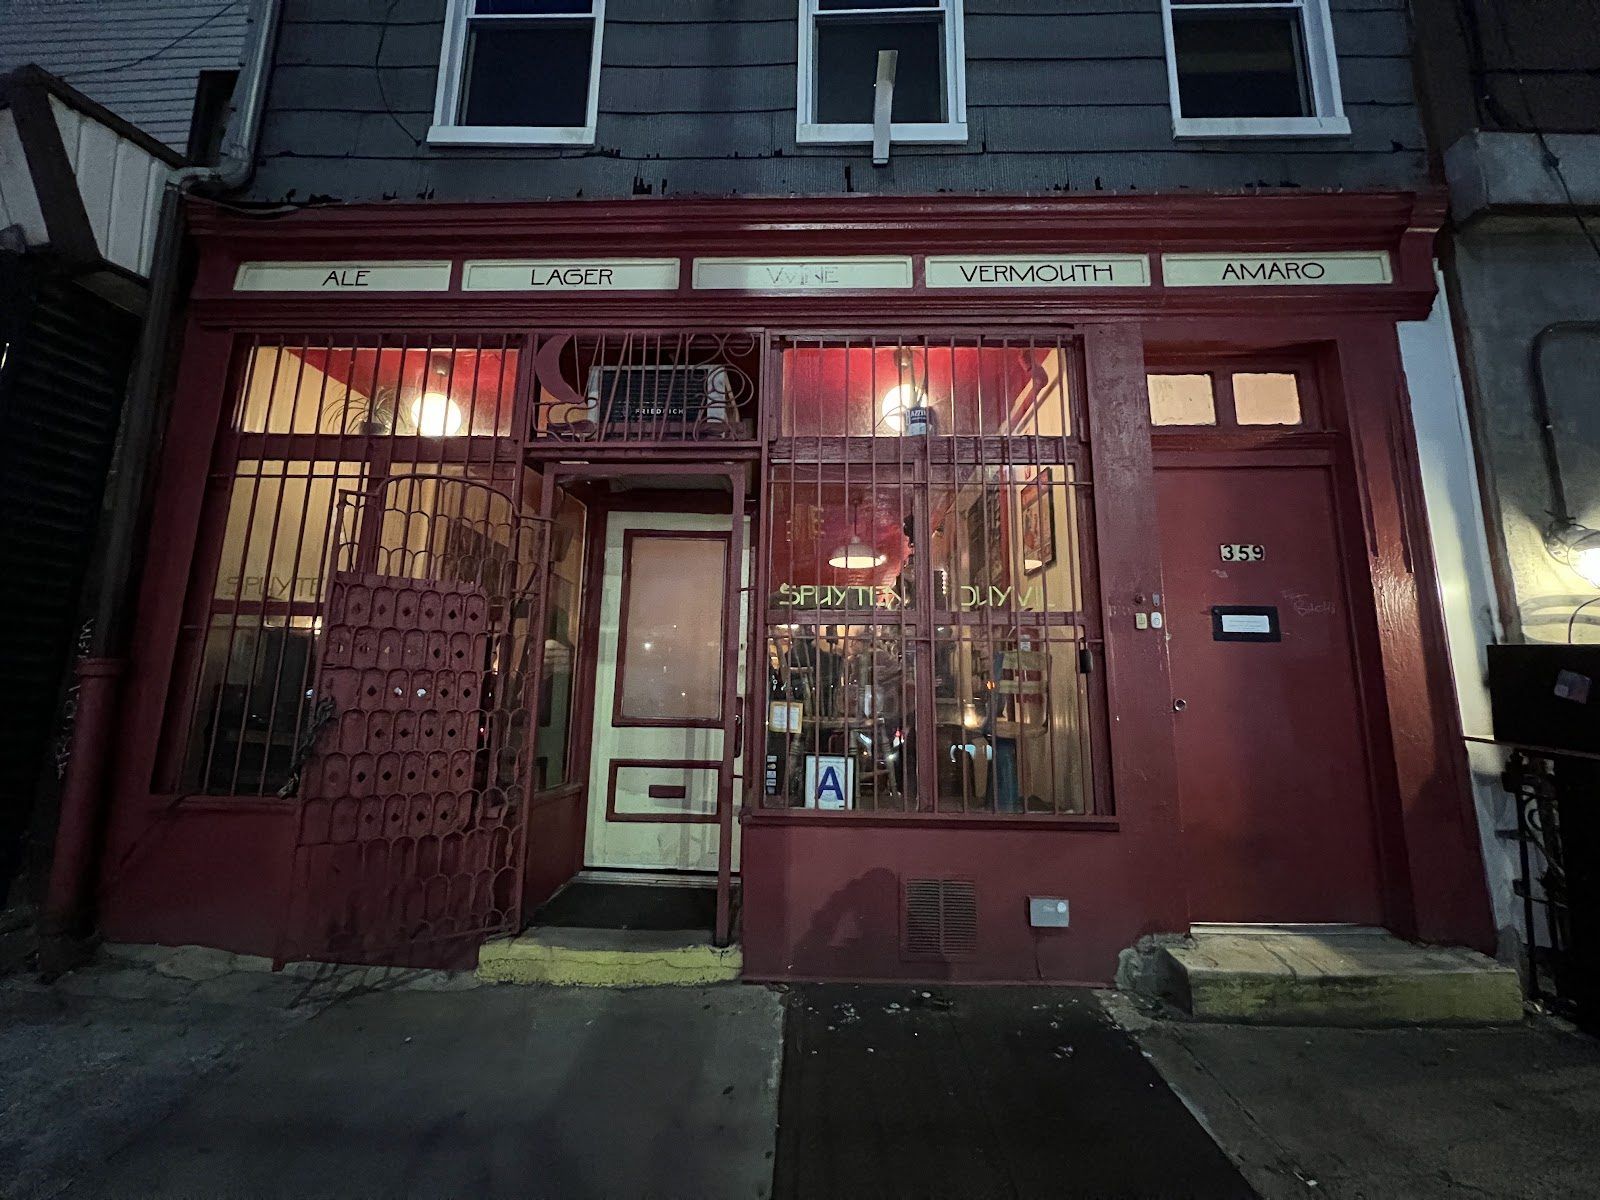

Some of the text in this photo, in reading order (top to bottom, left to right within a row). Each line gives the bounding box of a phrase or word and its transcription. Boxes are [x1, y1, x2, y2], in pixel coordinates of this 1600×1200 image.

[322, 270, 370, 286] ALE
[530, 268, 612, 286] LAGER
[959, 263, 1114, 283] VERMOUTH
[1221, 262, 1325, 281] AMARO
[1222, 545, 1264, 561] 359
[817, 765, 845, 801] A
